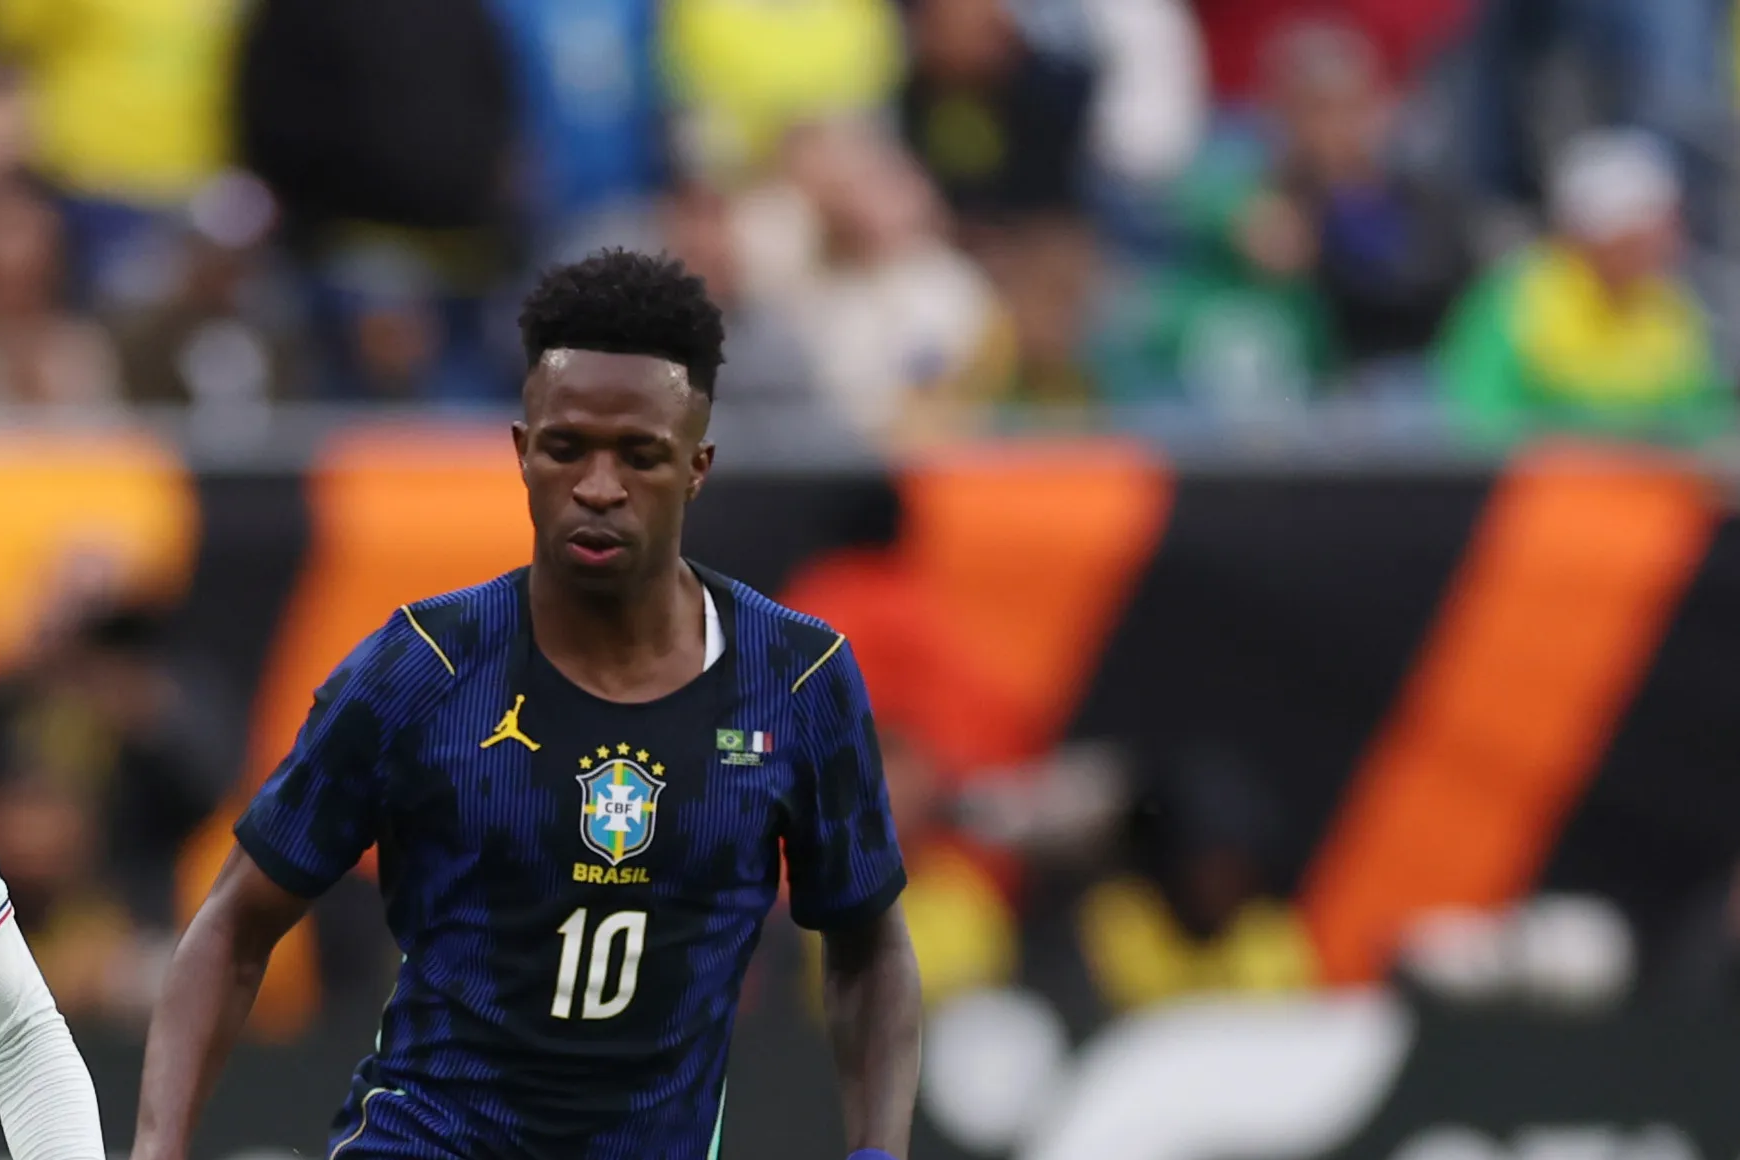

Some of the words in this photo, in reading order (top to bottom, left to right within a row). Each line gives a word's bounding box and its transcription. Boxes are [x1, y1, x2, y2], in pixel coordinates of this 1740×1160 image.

[605, 801, 633, 815] CBF
[572, 862, 650, 884] BRASIL
[550, 907, 647, 1020] 10
